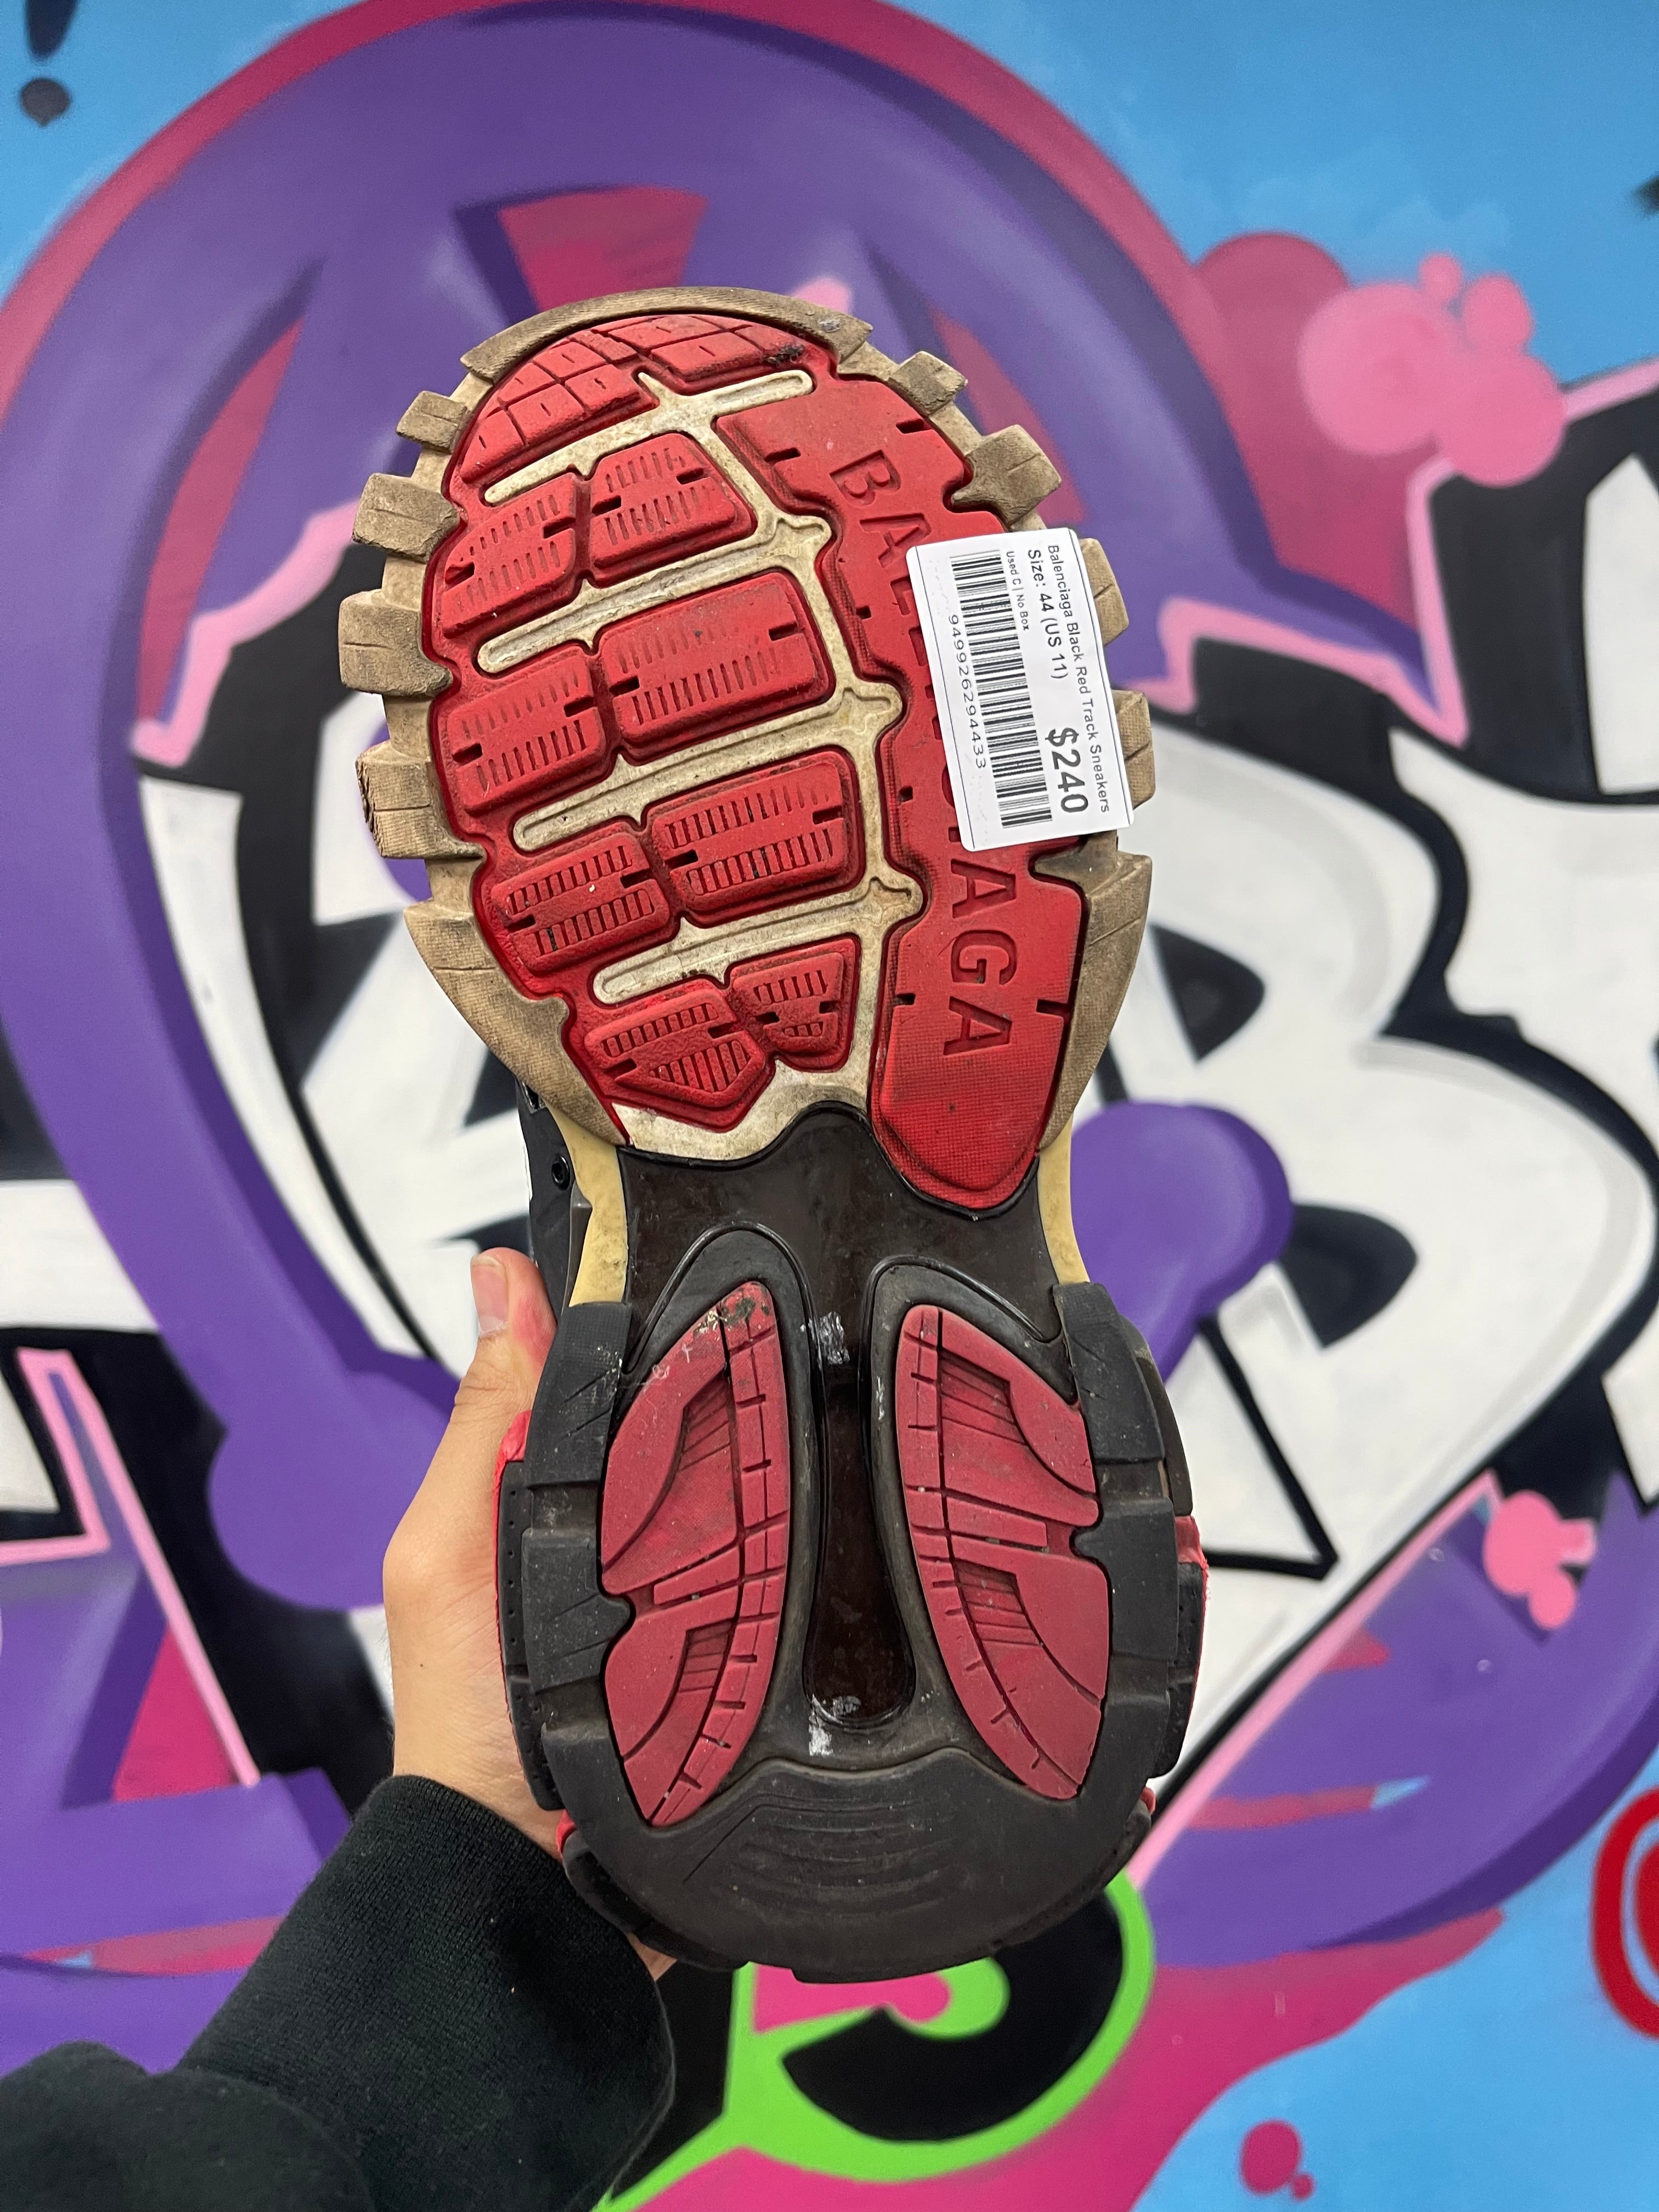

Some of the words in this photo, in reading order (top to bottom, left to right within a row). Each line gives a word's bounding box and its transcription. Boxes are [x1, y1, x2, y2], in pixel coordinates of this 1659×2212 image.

[1006, 551, 1018, 575] Used
[1028, 550, 1046, 587] Size:
[1048, 545, 1073, 617] Balenciaga
[1016, 594, 1024, 608] No
[1039, 594, 1054, 612] 44
[1019, 611, 1030, 631] Box
[1040, 618, 1062, 647] (US
[1066, 623, 1085, 662] Black
[1051, 653, 1069, 679] 11)
[1076, 667, 1091, 694] Red
[949, 614, 986, 769] 949926294433
[1082, 698, 1098, 740] Track
[830, 450, 1017, 1057] BAAGA
[1045, 728, 1088, 813] $240
[1090, 744, 1109, 813] Sneakers
